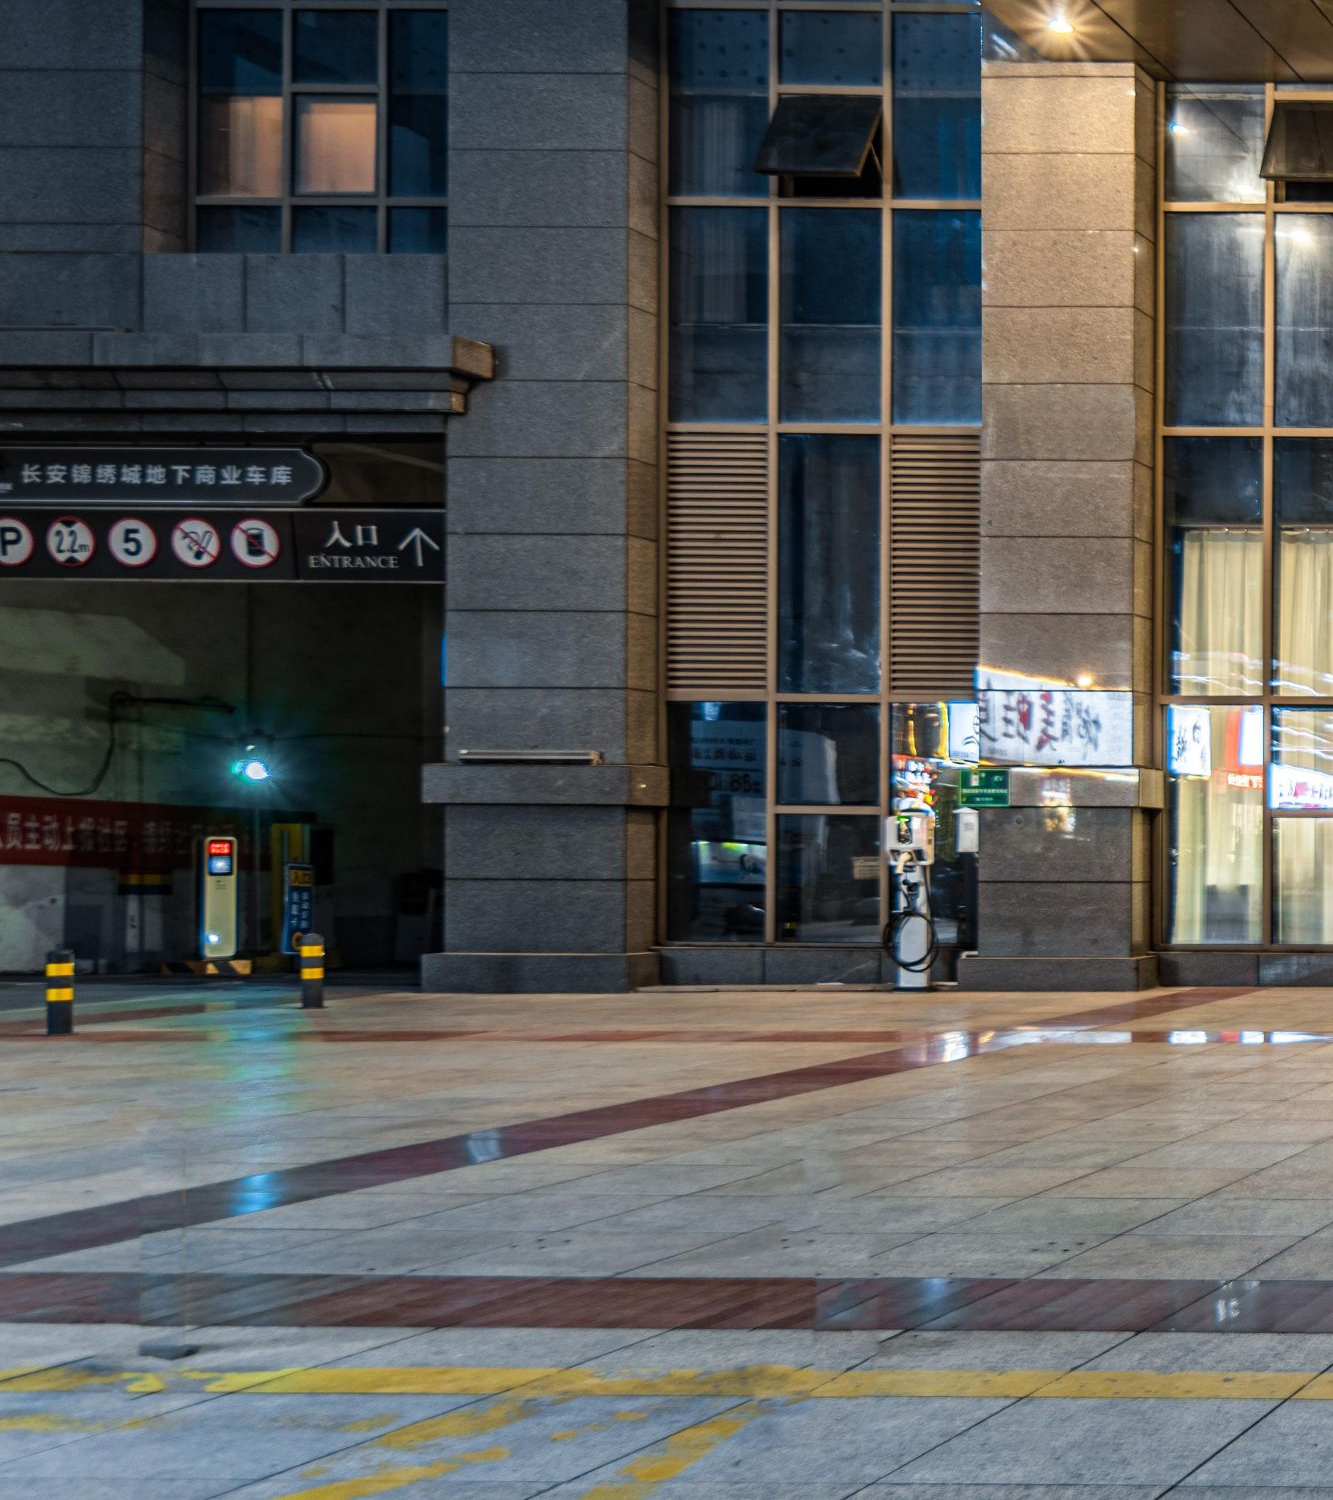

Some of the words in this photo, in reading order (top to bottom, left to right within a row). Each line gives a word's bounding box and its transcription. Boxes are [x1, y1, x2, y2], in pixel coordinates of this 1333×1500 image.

[21, 463, 294, 485] 长安锦绣城地下商业车库
[122, 527, 143, 557] 5
[324, 520, 379, 548] 入口
[308, 554, 400, 570] ENTRANCE
